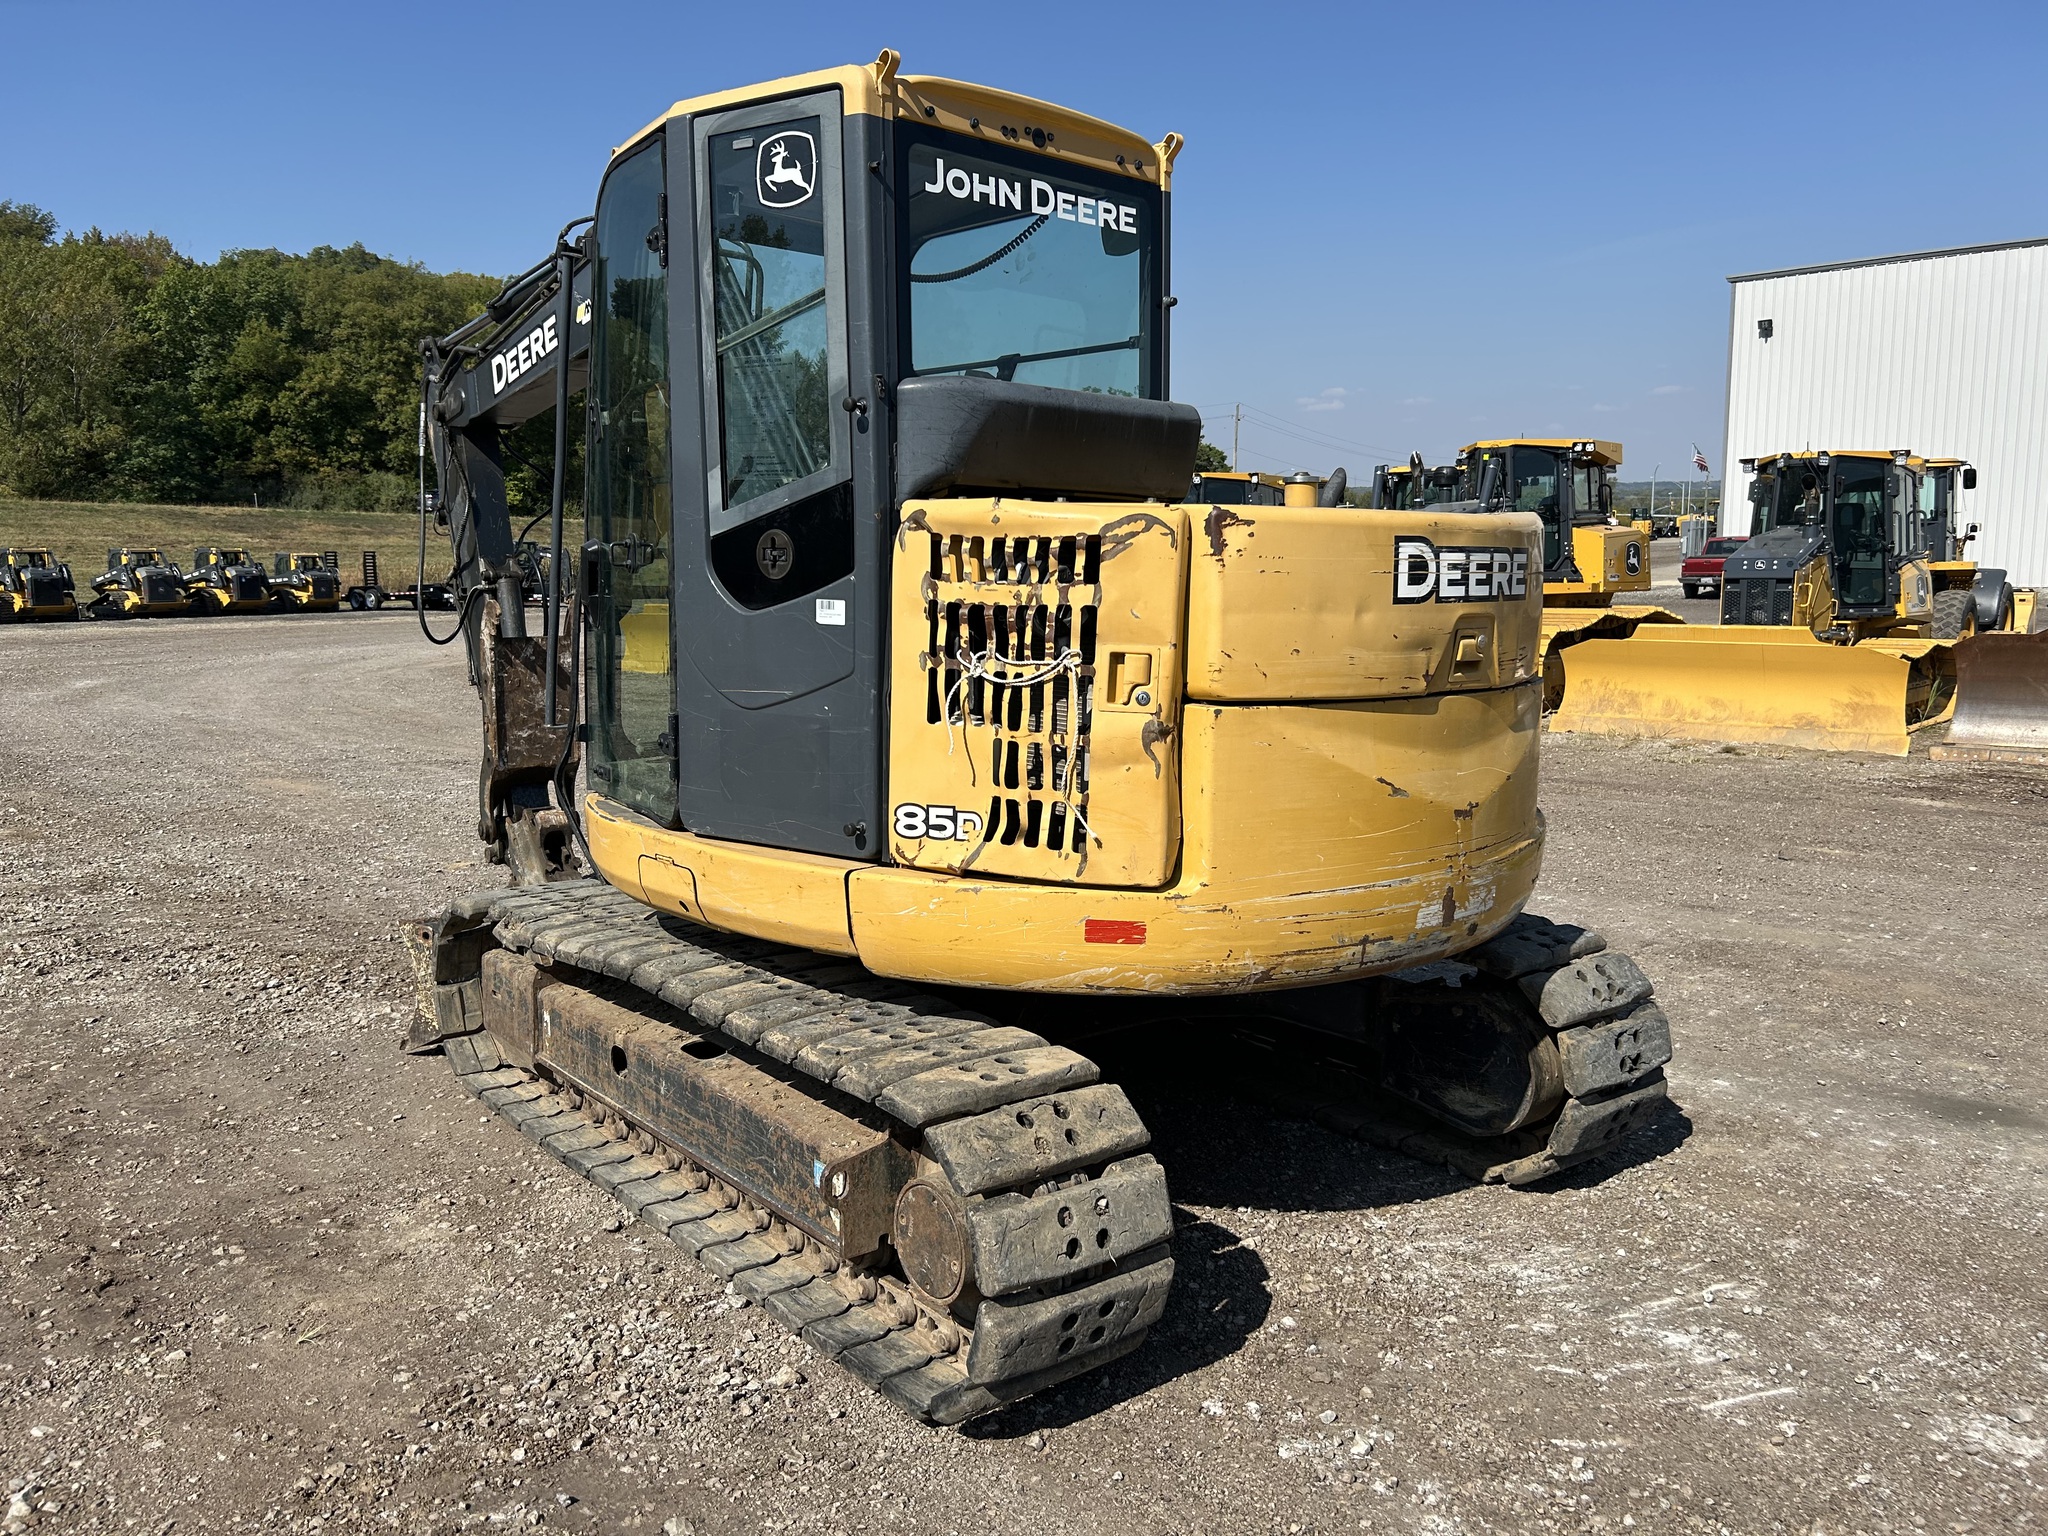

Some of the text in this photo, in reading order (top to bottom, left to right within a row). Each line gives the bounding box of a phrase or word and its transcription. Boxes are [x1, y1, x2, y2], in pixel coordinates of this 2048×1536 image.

[924, 157, 1137, 235] JOHN DEERE
[490, 314, 559, 395] DEERE
[1396, 540, 1528, 599] DEERE
[894, 803, 983, 841] 85D
